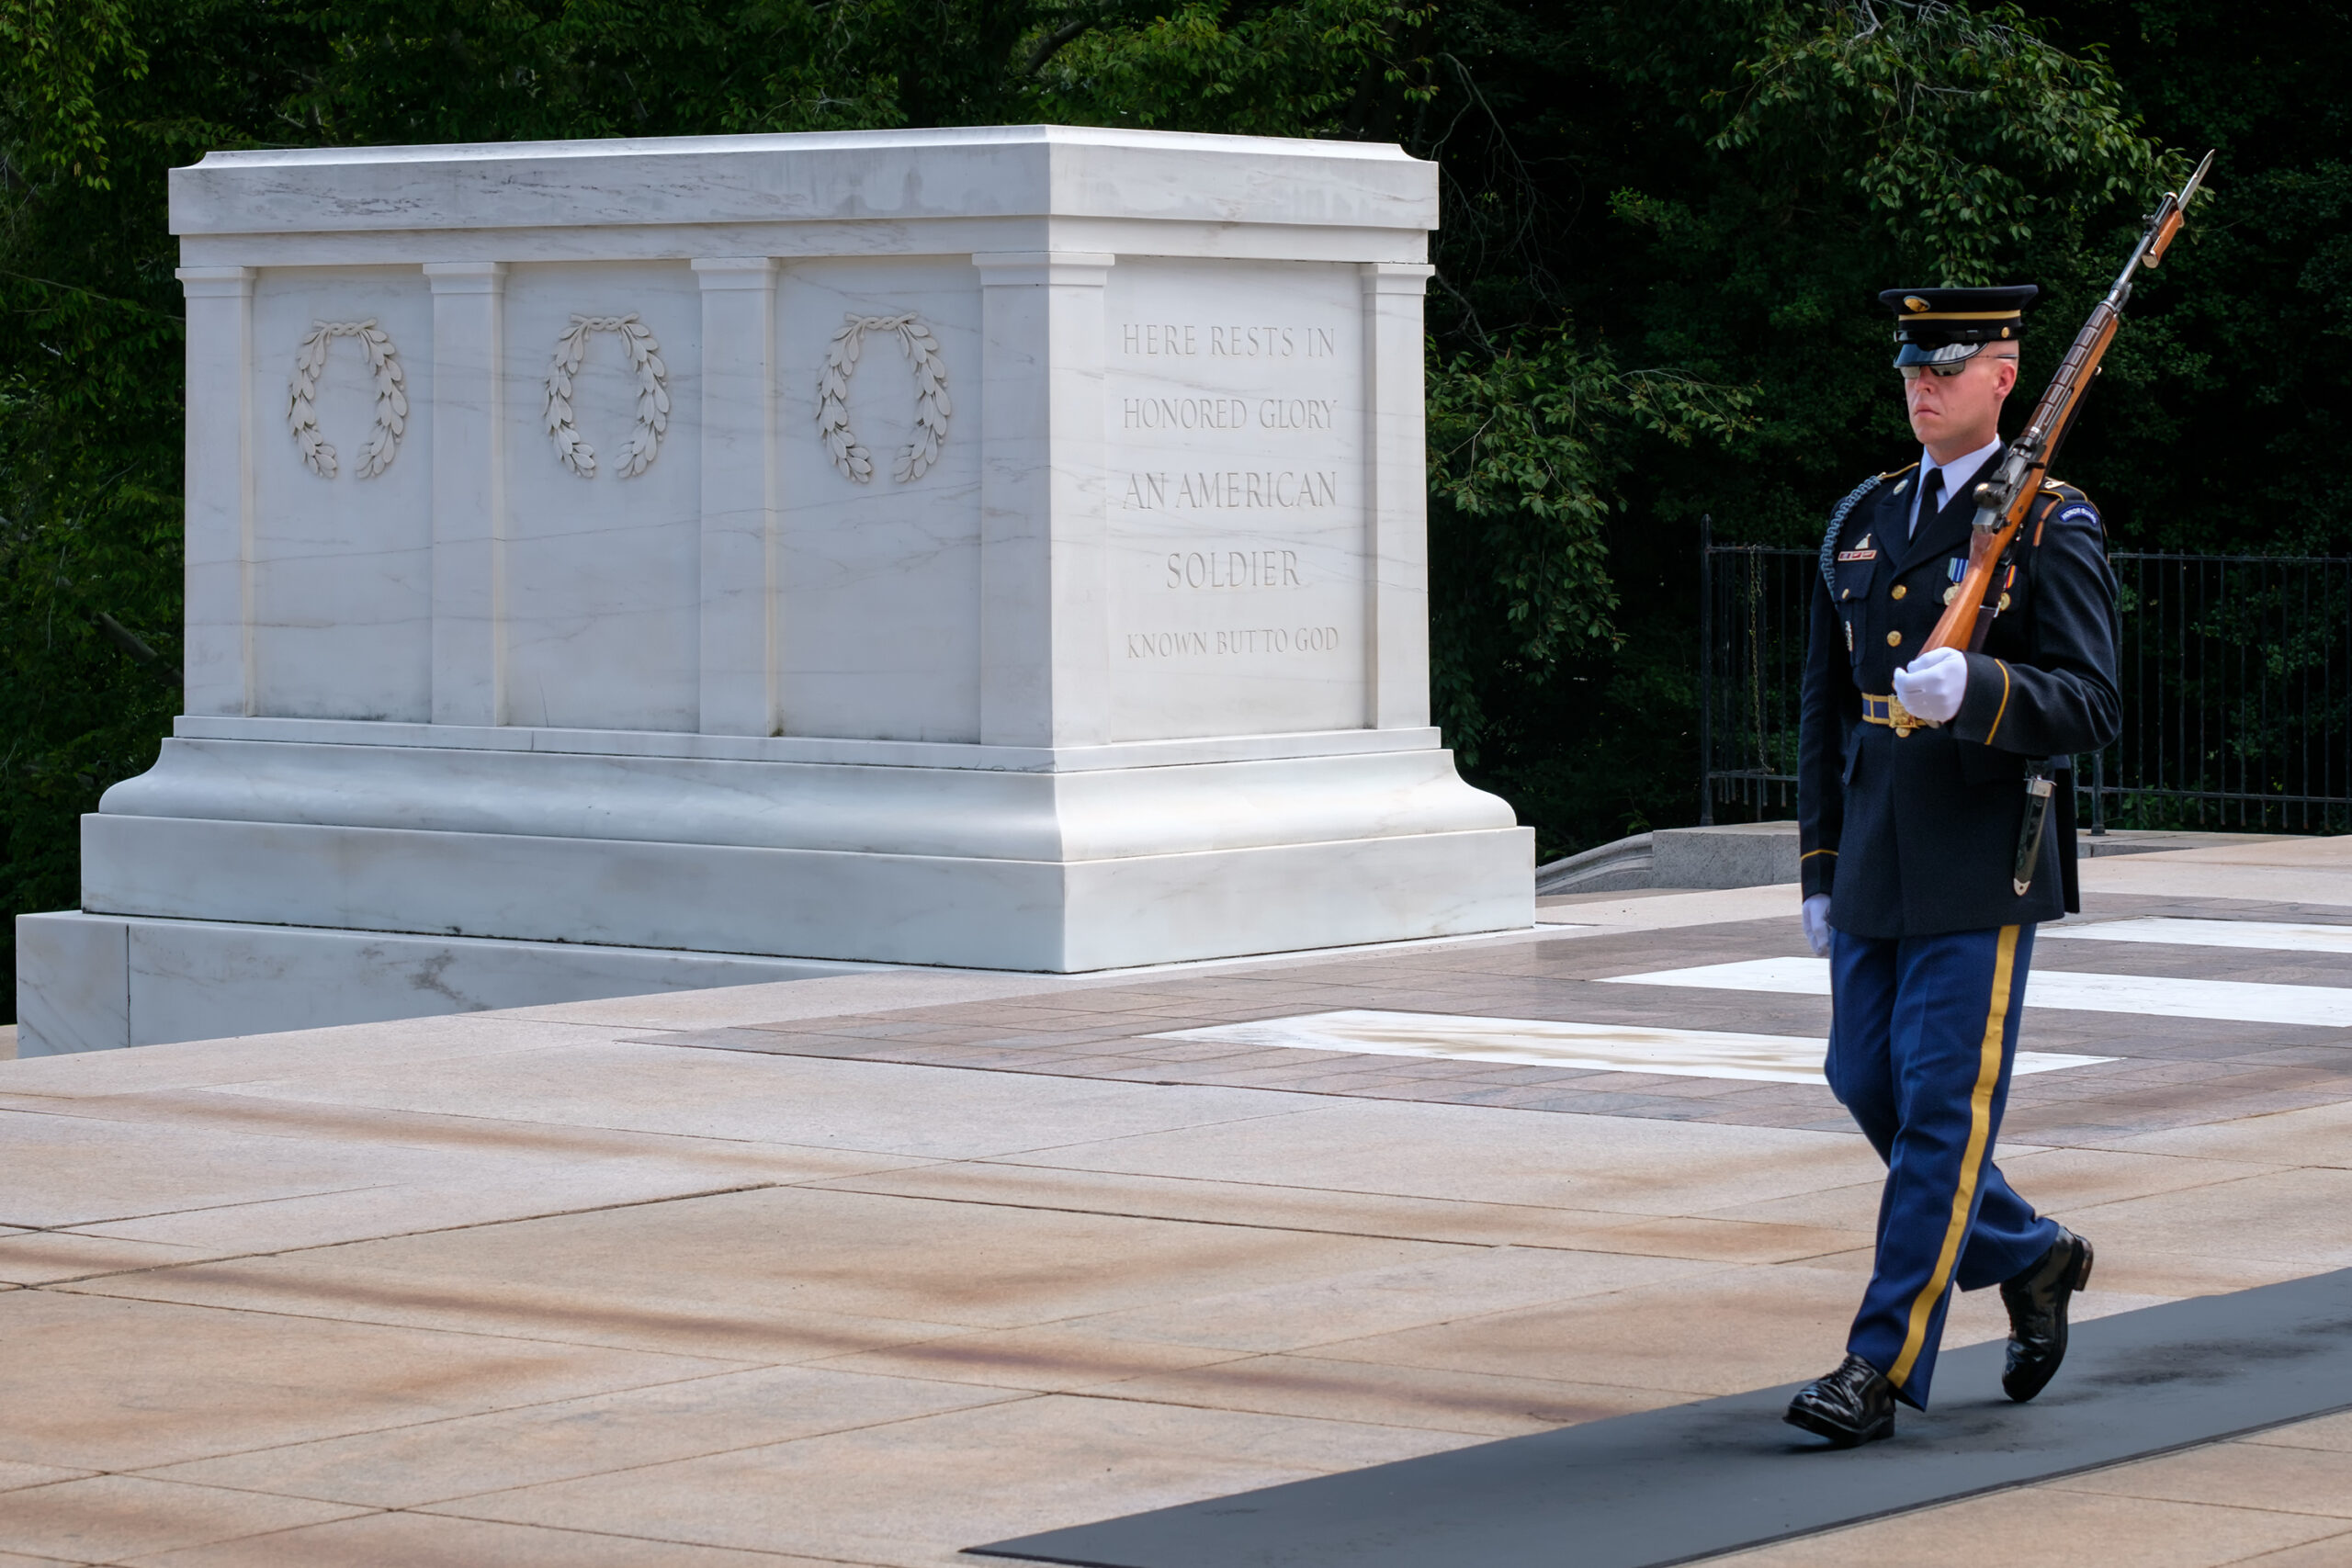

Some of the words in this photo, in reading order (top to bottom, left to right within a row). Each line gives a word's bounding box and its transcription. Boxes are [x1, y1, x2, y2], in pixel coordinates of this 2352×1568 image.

[1123, 324, 1195, 355] HERE
[1210, 325, 1294, 357] RESTS
[1307, 328, 1334, 357] IN
[1124, 398, 1247, 429] HONORED
[1259, 399, 1338, 429] GLORY
[1123, 472, 1165, 509] AN
[1176, 471, 1337, 508] AMERICAN
[1167, 550, 1301, 589] SOLDIER
[1127, 631, 1206, 659] KNOWN
[1216, 629, 1256, 655] BUT
[1259, 628, 1288, 653] TO
[1295, 626, 1339, 652] GOD
